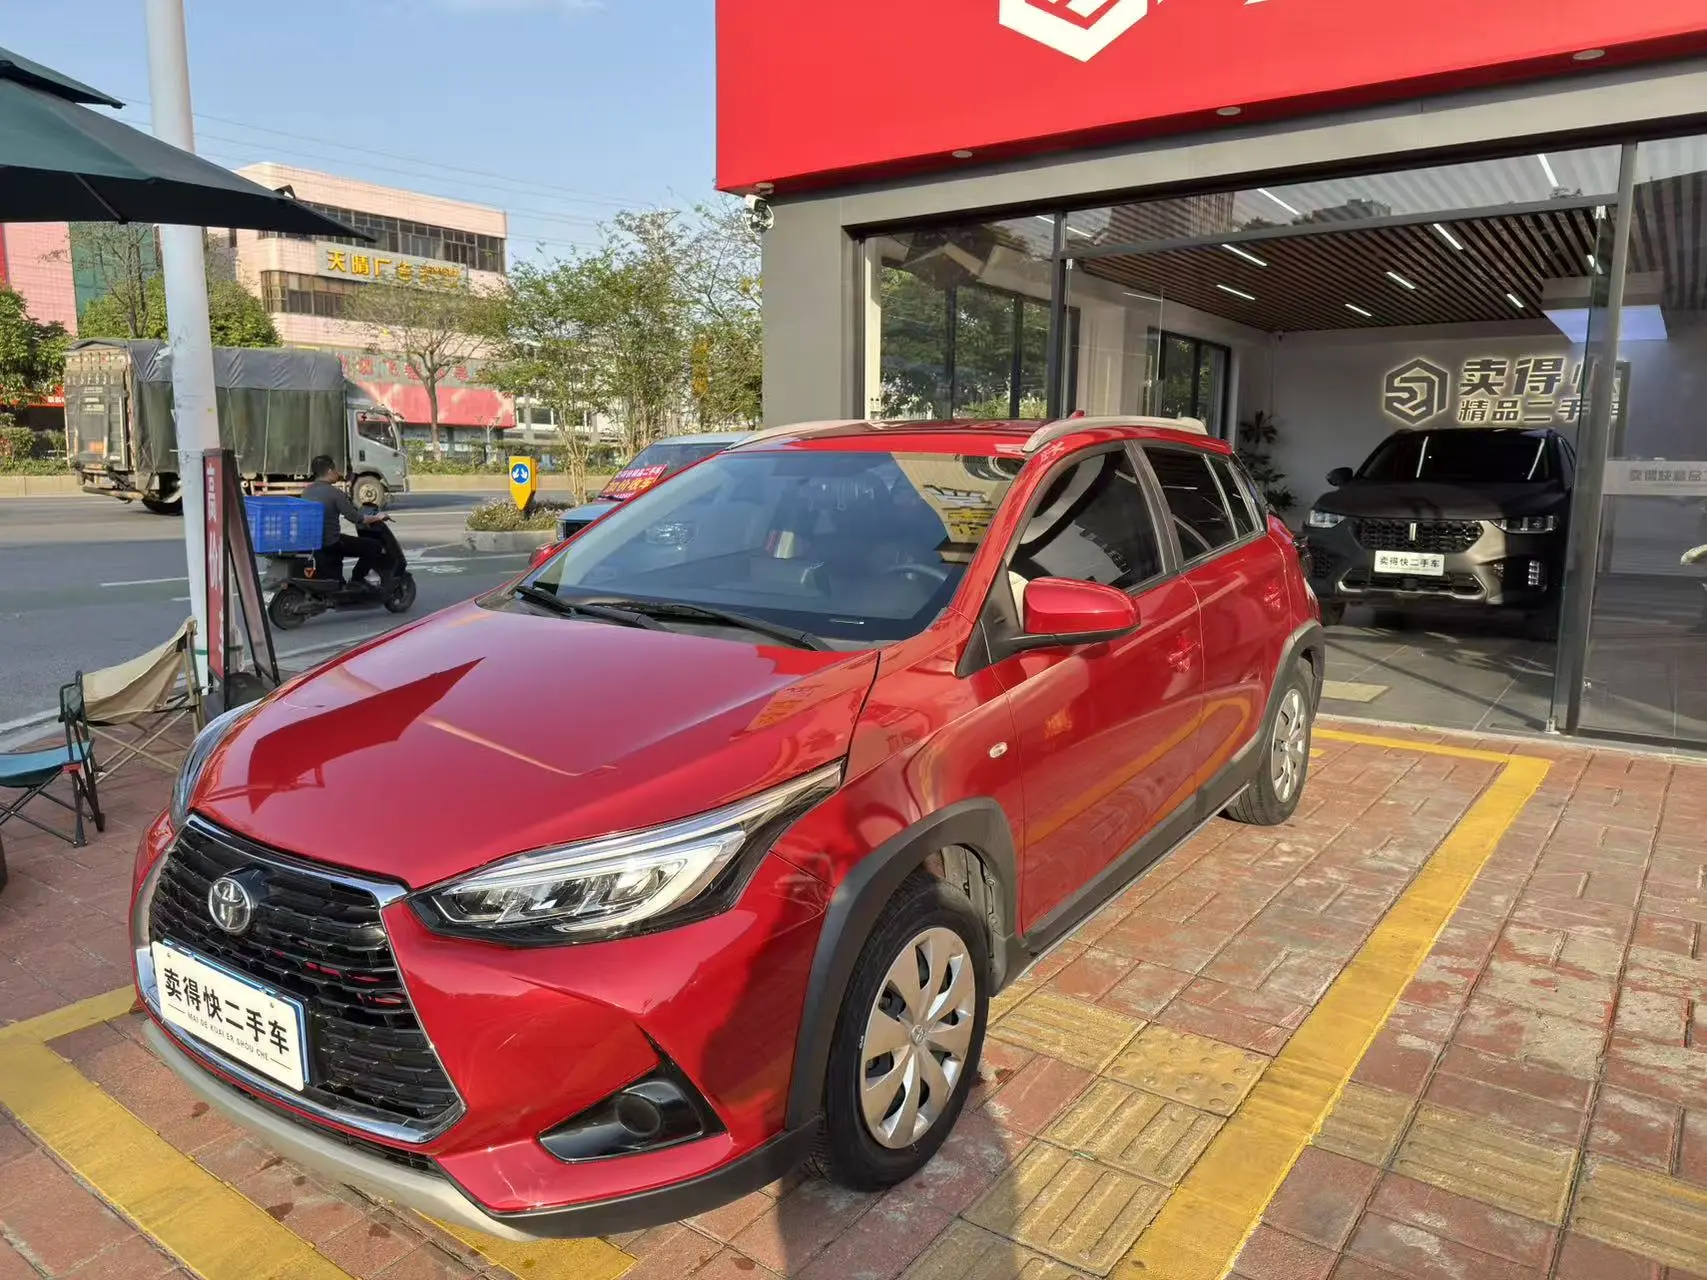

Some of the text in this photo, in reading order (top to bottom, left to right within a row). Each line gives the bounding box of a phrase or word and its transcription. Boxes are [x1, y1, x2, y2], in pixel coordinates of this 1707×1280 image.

[1379, 556, 1440, 568] 卖得快二手车
[164, 968, 290, 1055] 卖得快二手车
